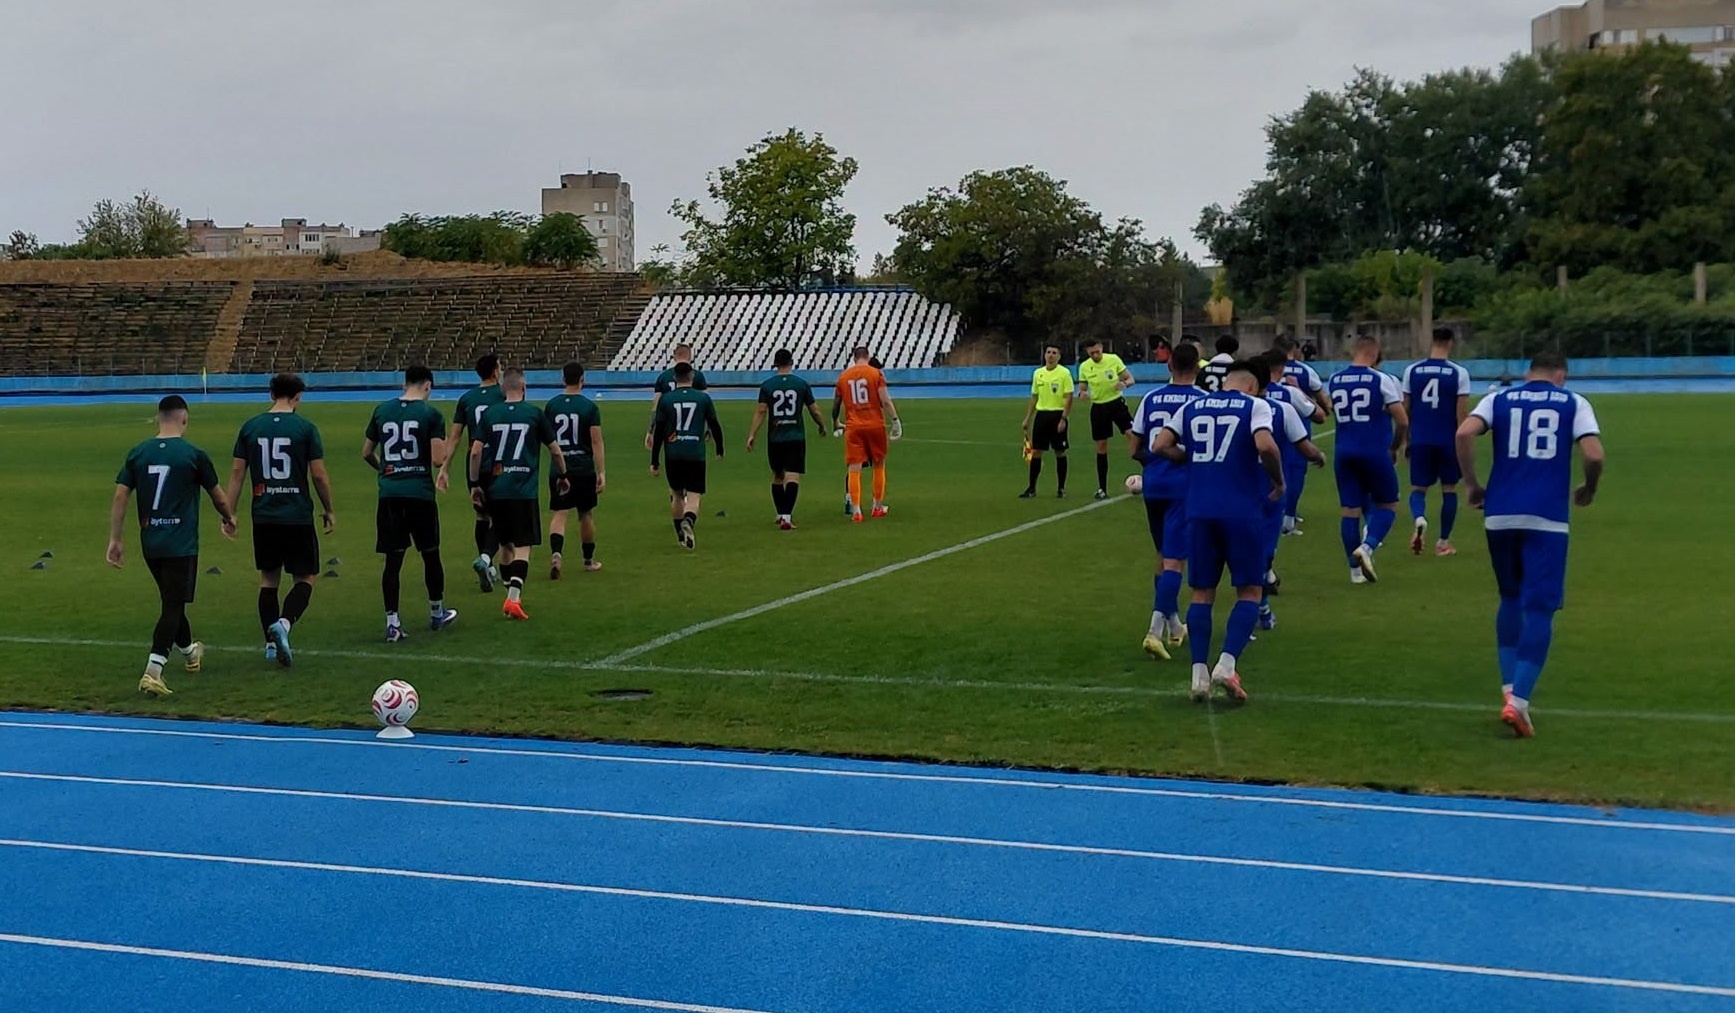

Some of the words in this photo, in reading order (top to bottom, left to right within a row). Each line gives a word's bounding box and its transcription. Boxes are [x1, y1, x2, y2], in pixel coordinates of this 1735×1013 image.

[848, 378, 868, 405] 16
[1205, 375, 1228, 392] 3
[1421, 378, 1440, 409] 4
[674, 402, 697, 431] 17
[773, 389, 798, 417] 23
[1332, 388, 1371, 423] 22
[382, 420, 420, 461] 25
[492, 423, 530, 461] 77
[554, 413, 579, 446] 21
[1190, 415, 1241, 463] 97
[1508, 407, 1560, 459] 18
[257, 437, 292, 480] 15
[148, 465, 171, 511] 7
